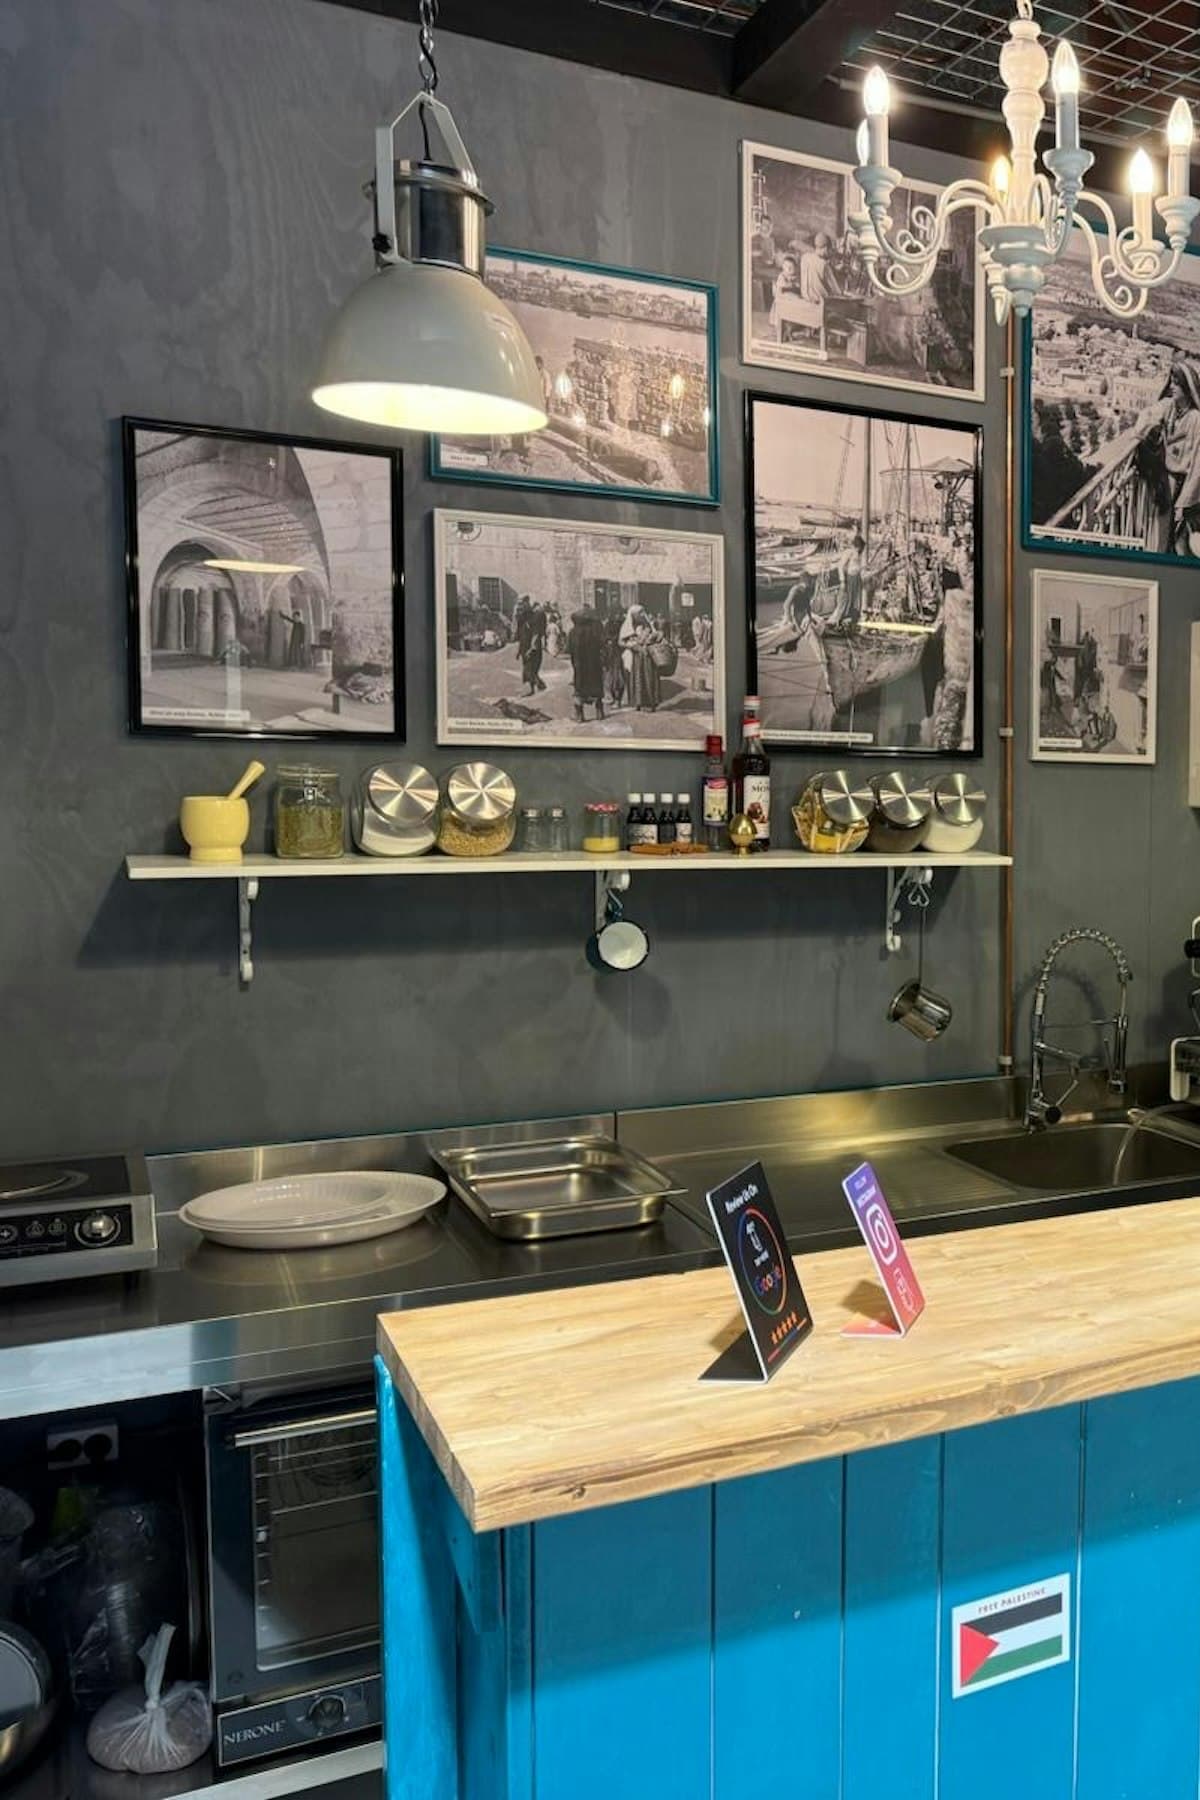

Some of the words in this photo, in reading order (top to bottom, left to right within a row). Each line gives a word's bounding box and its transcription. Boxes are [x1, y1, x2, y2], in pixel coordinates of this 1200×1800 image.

[978, 1601, 999, 1614] FREE
[1001, 1587, 1046, 1607] PALESTINE
[223, 1720, 286, 1744] NERONE
